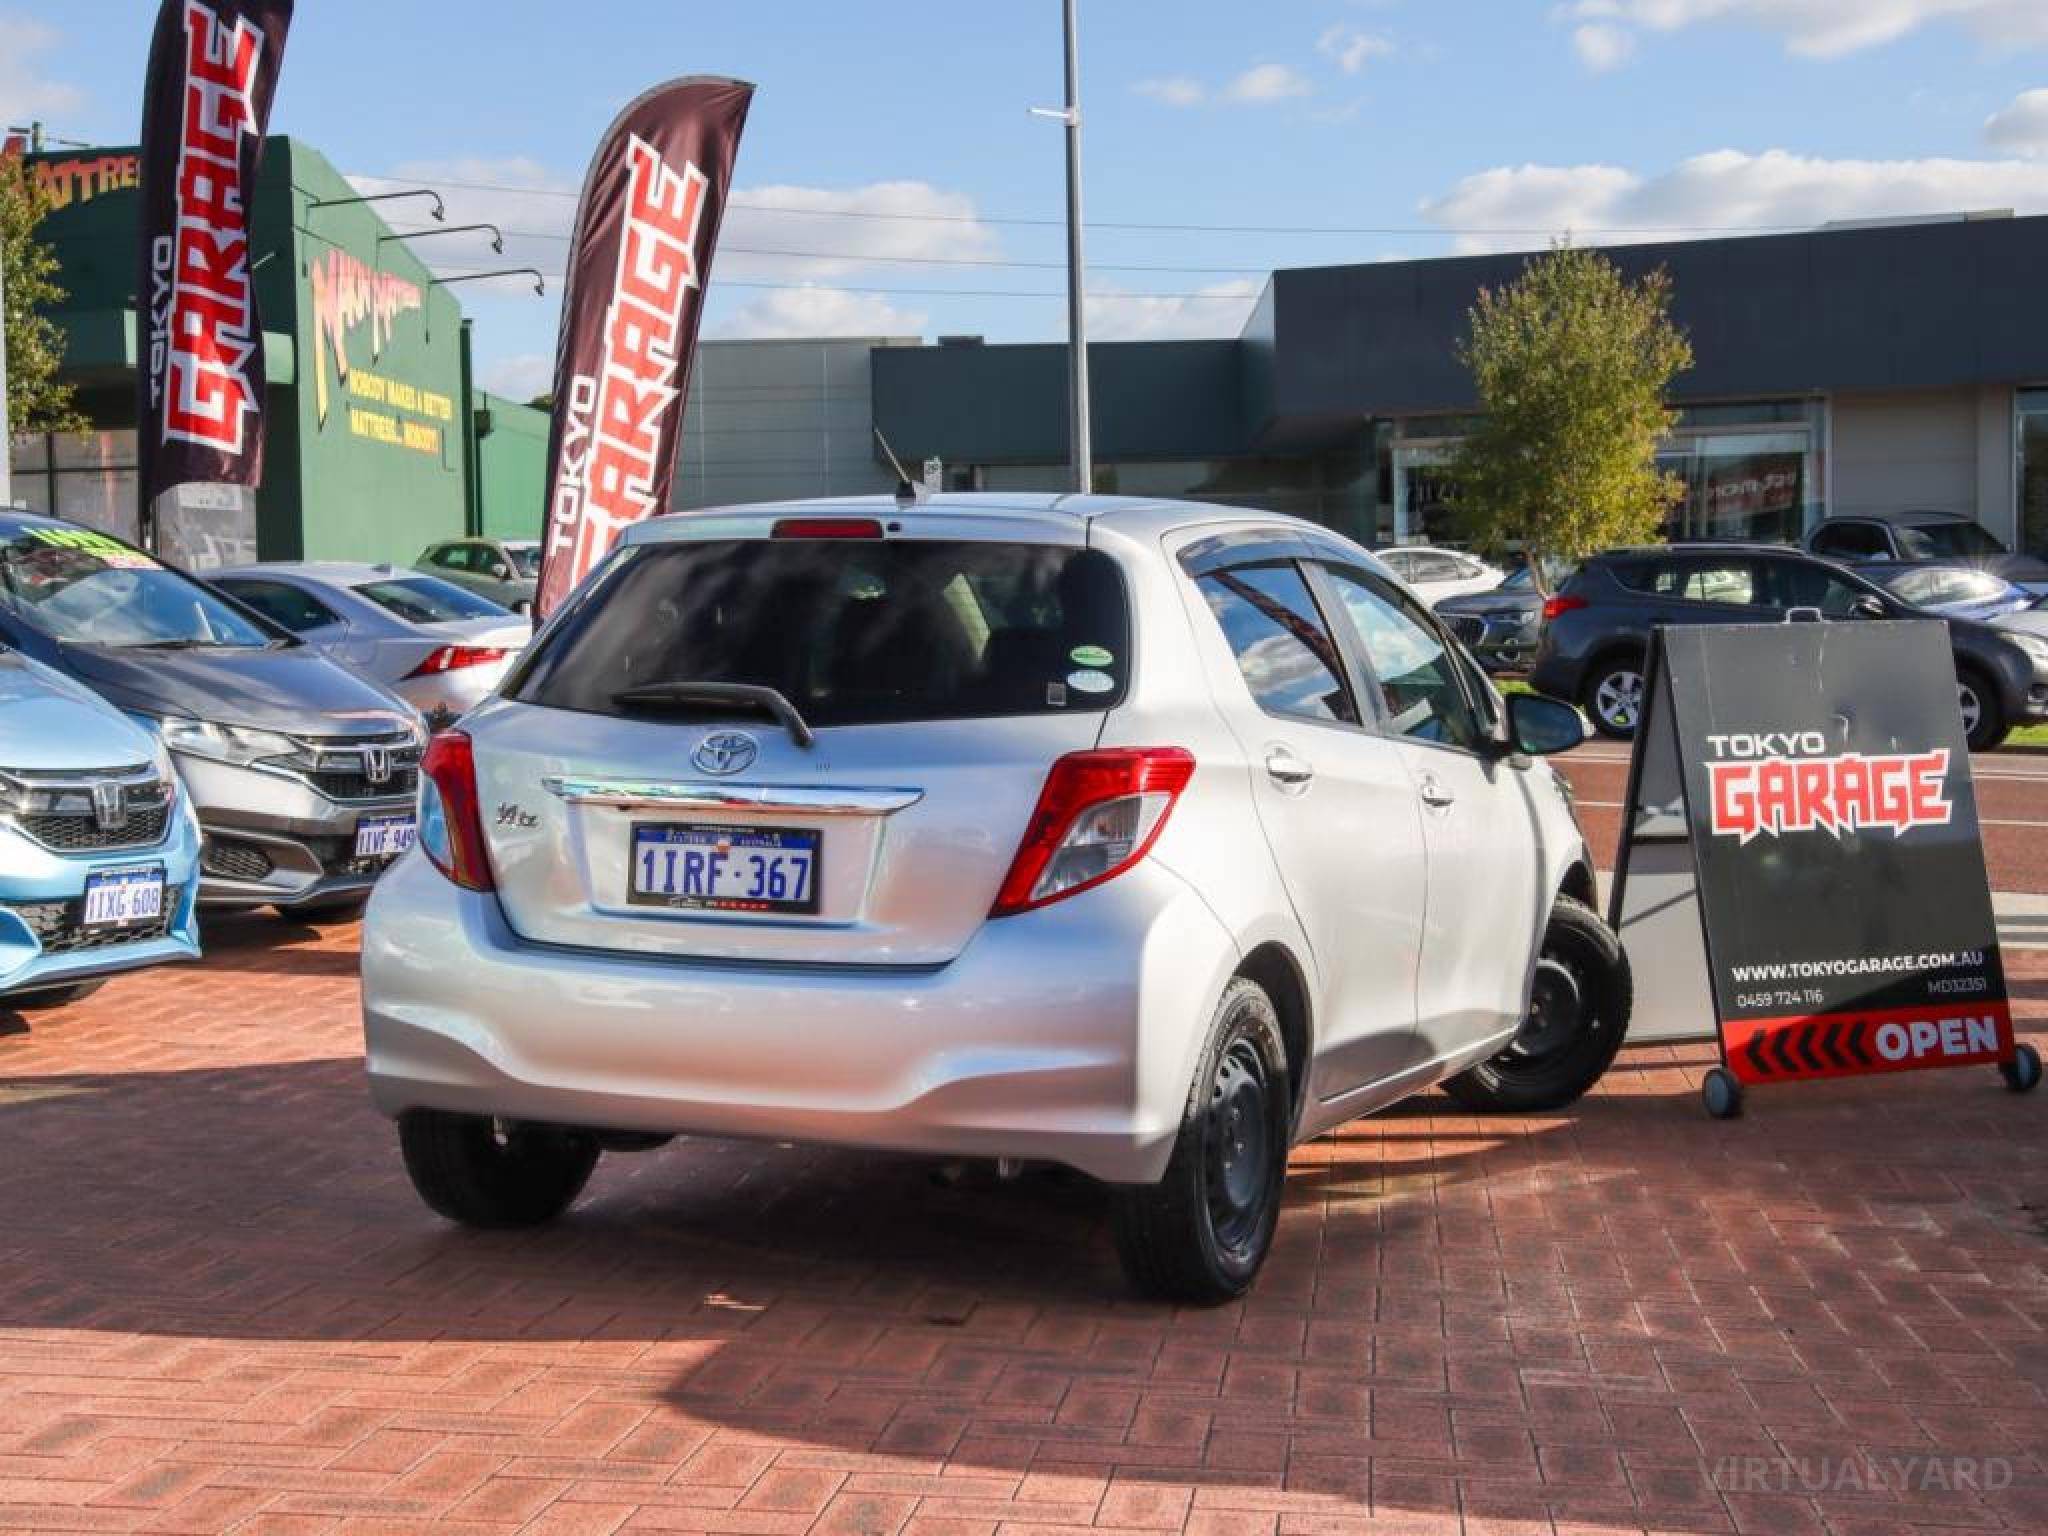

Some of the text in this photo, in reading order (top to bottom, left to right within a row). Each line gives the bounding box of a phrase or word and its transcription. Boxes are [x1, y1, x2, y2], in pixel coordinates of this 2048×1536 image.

[162, 2, 264, 455] GARAGE
[150, 236, 173, 410] TOKYO
[548, 375, 597, 557] TOKYO
[1706, 732, 1826, 758] TOKYO
[1704, 748, 1953, 848] GARAGE
[1731, 951, 1984, 983] WWW.TOKYOGARAGE.COM.AU
[1737, 991, 1773, 1008] 0459
[1774, 988, 1801, 1006] 724
[1876, 1015, 1999, 1062] OPEN
